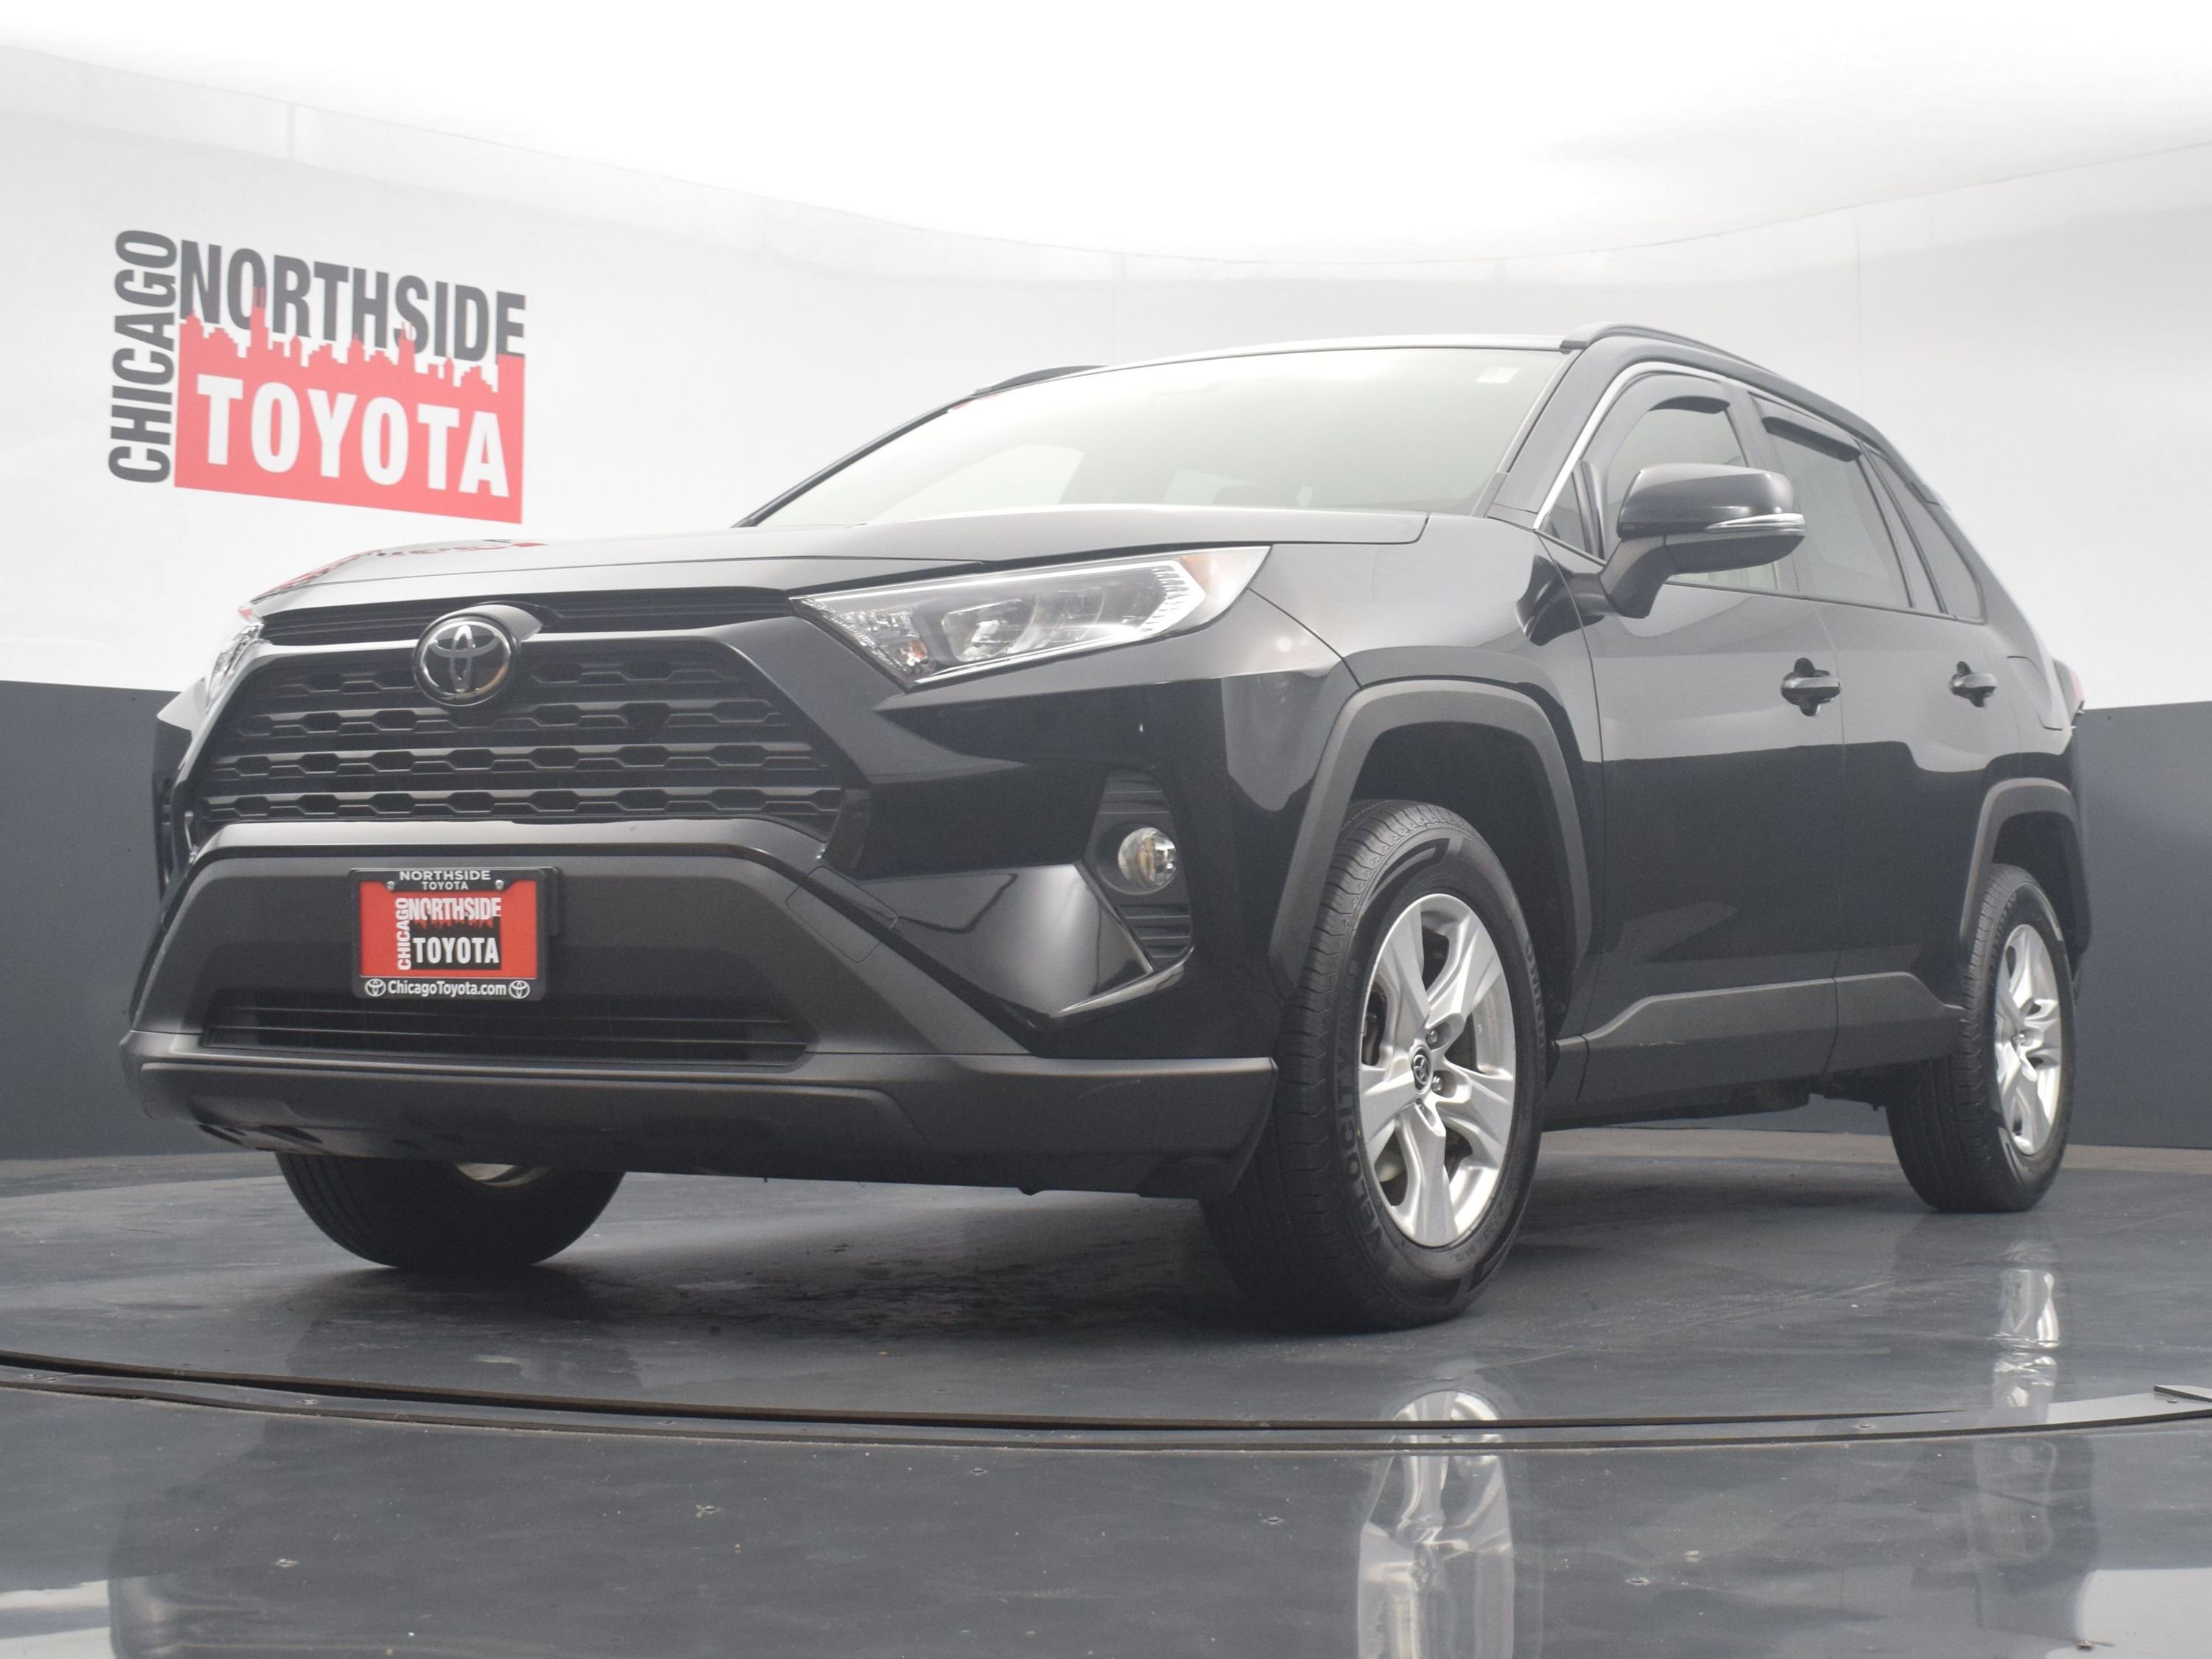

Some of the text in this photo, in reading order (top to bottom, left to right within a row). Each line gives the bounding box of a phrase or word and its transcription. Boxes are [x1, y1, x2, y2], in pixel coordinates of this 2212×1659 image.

[180, 239, 526, 363] NORTHSIDE
[108, 230, 178, 484] CHICAGO
[197, 374, 510, 498] TOYOTA
[399, 871, 491, 881] NORTHSIDE
[422, 881, 469, 891] TOYOTA
[408, 897, 501, 920] NORTHSIDE
[395, 897, 411, 970] CHICAGO
[413, 937, 499, 964] TOYOTA
[388, 981, 507, 997] ChicagoToyota.com
